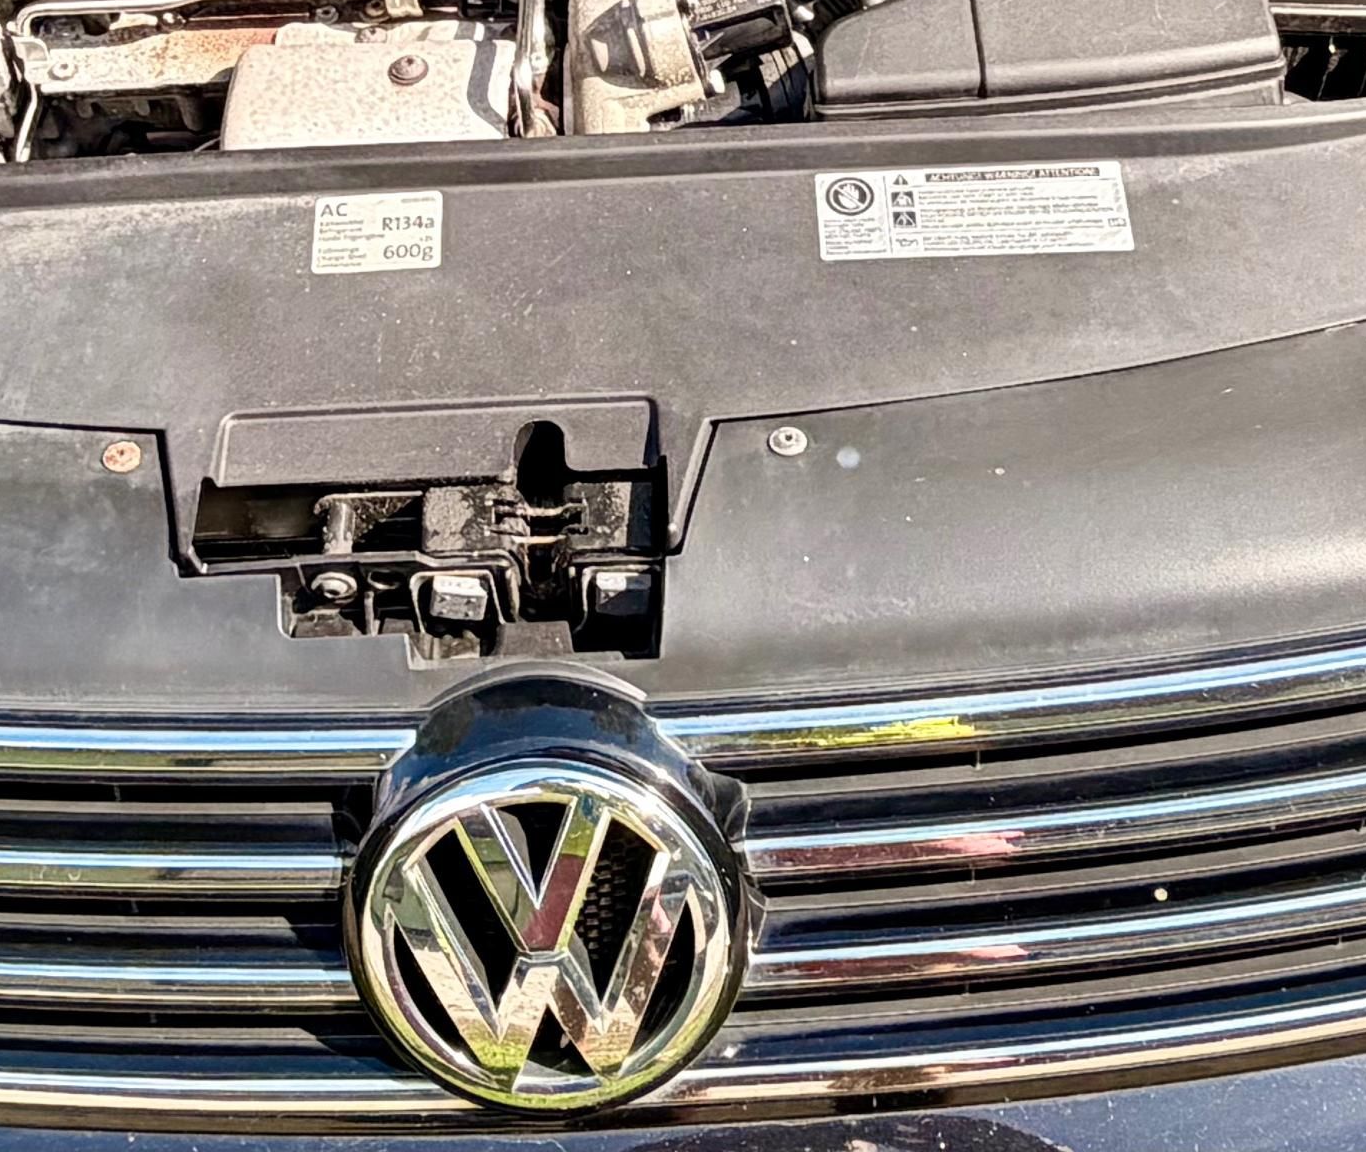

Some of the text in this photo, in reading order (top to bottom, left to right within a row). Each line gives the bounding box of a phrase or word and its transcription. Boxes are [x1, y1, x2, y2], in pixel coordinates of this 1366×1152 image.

[320, 203, 348, 217] AC
[381, 216, 436, 231] R134a
[383, 243, 434, 261] 600g
